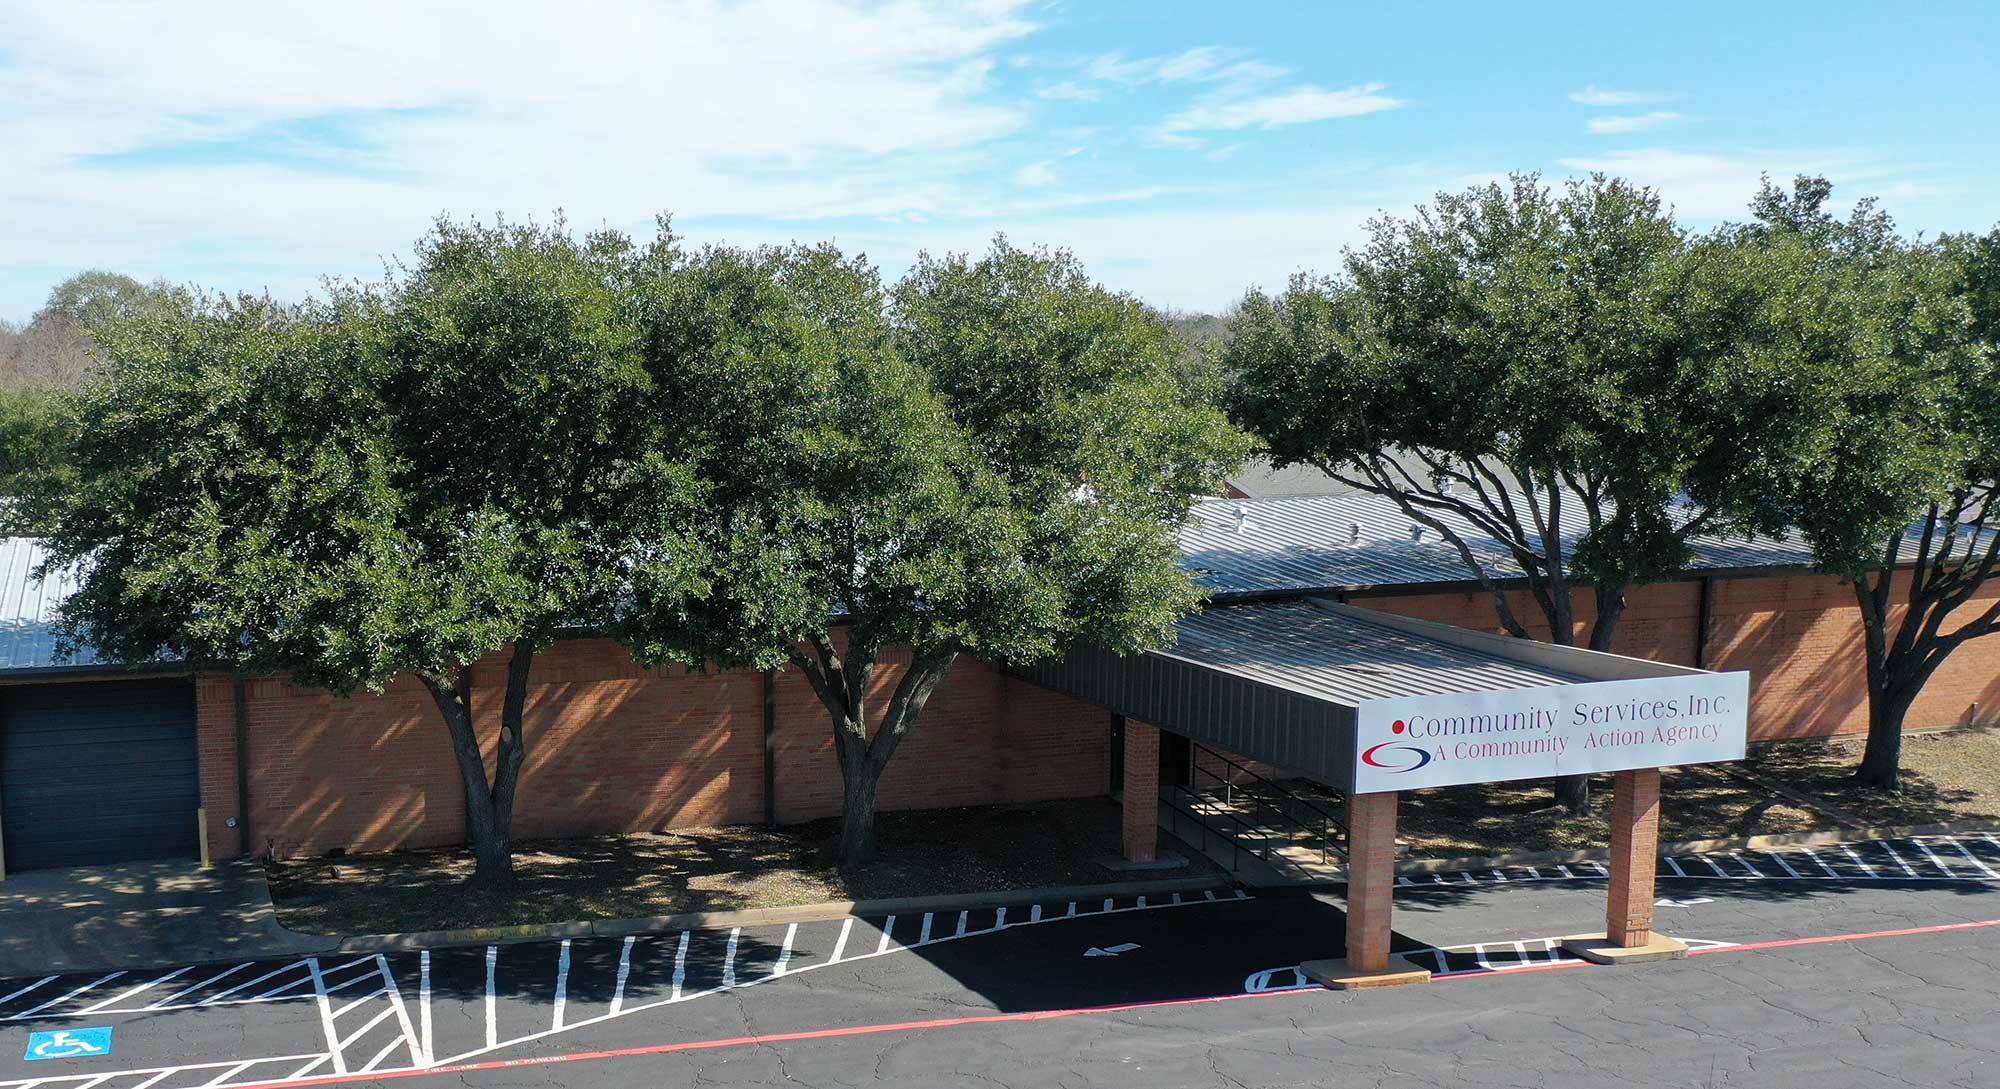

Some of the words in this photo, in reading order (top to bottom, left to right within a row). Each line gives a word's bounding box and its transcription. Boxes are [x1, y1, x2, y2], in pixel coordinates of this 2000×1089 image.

[1408, 706, 1558, 738] Community
[1433, 744, 1446, 761] A
[1455, 734, 1569, 760] Community
[1584, 728, 1644, 749] Action
[1651, 723, 1722, 746] Agency
[524, 1056, 567, 1064] PARKING
